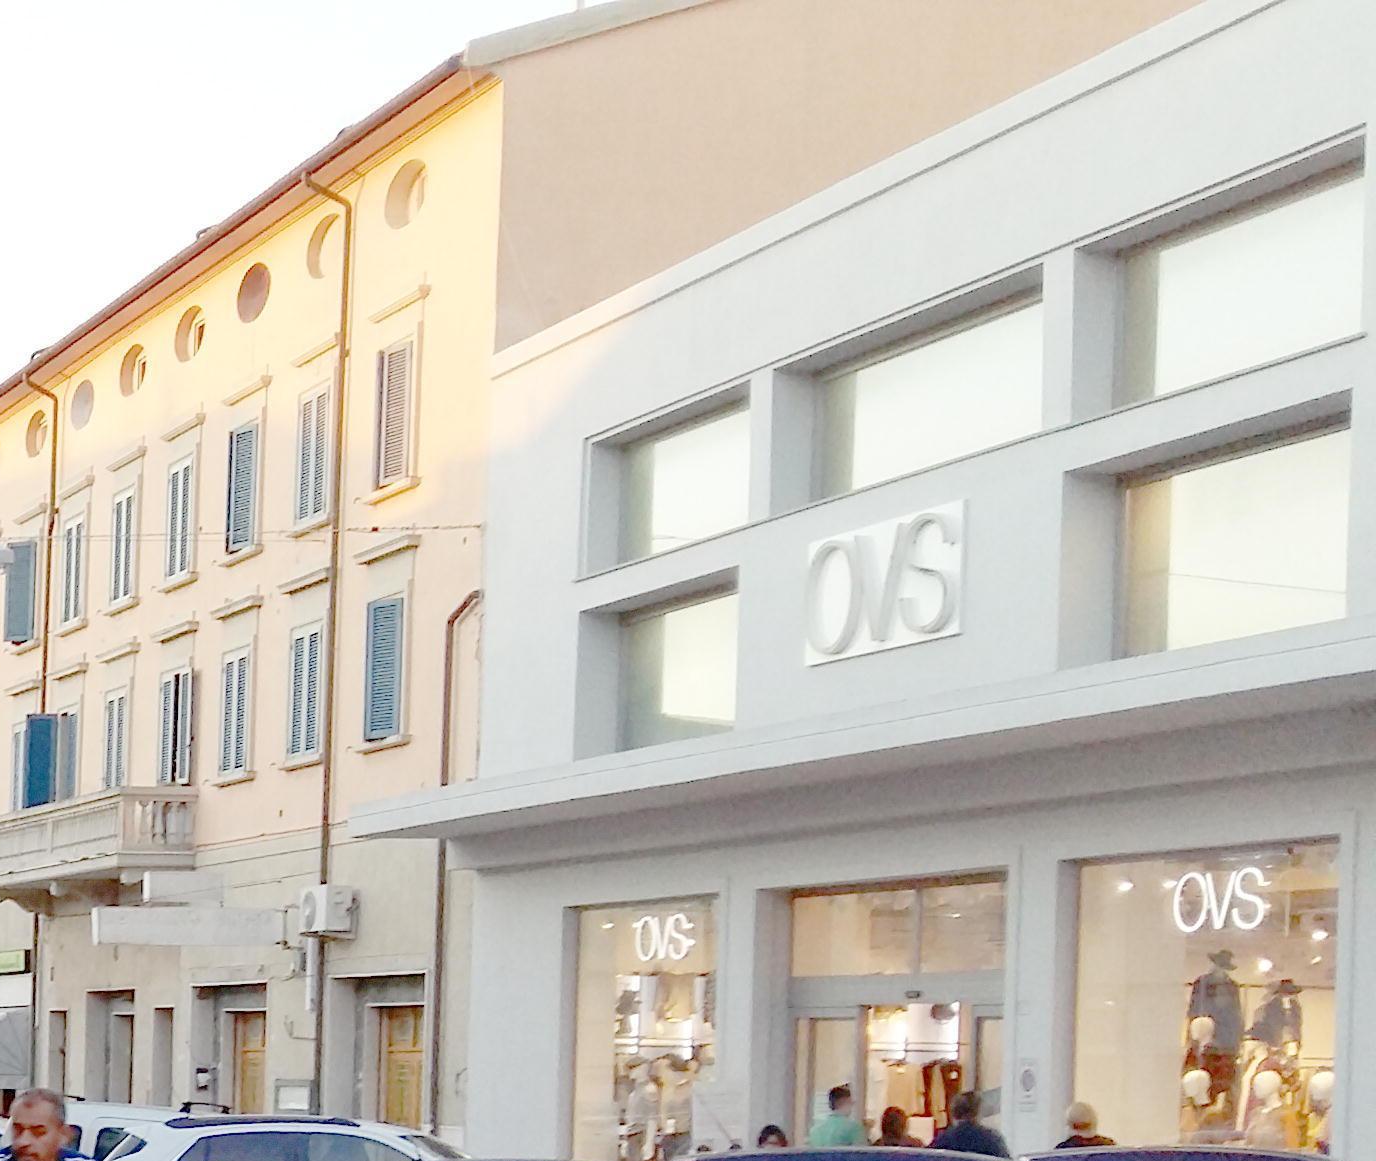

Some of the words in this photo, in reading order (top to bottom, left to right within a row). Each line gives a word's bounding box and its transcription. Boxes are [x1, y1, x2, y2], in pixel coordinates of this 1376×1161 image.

[805, 513, 956, 655] OVS
[1173, 866, 1272, 933] OVS
[632, 912, 696, 962] OVS
